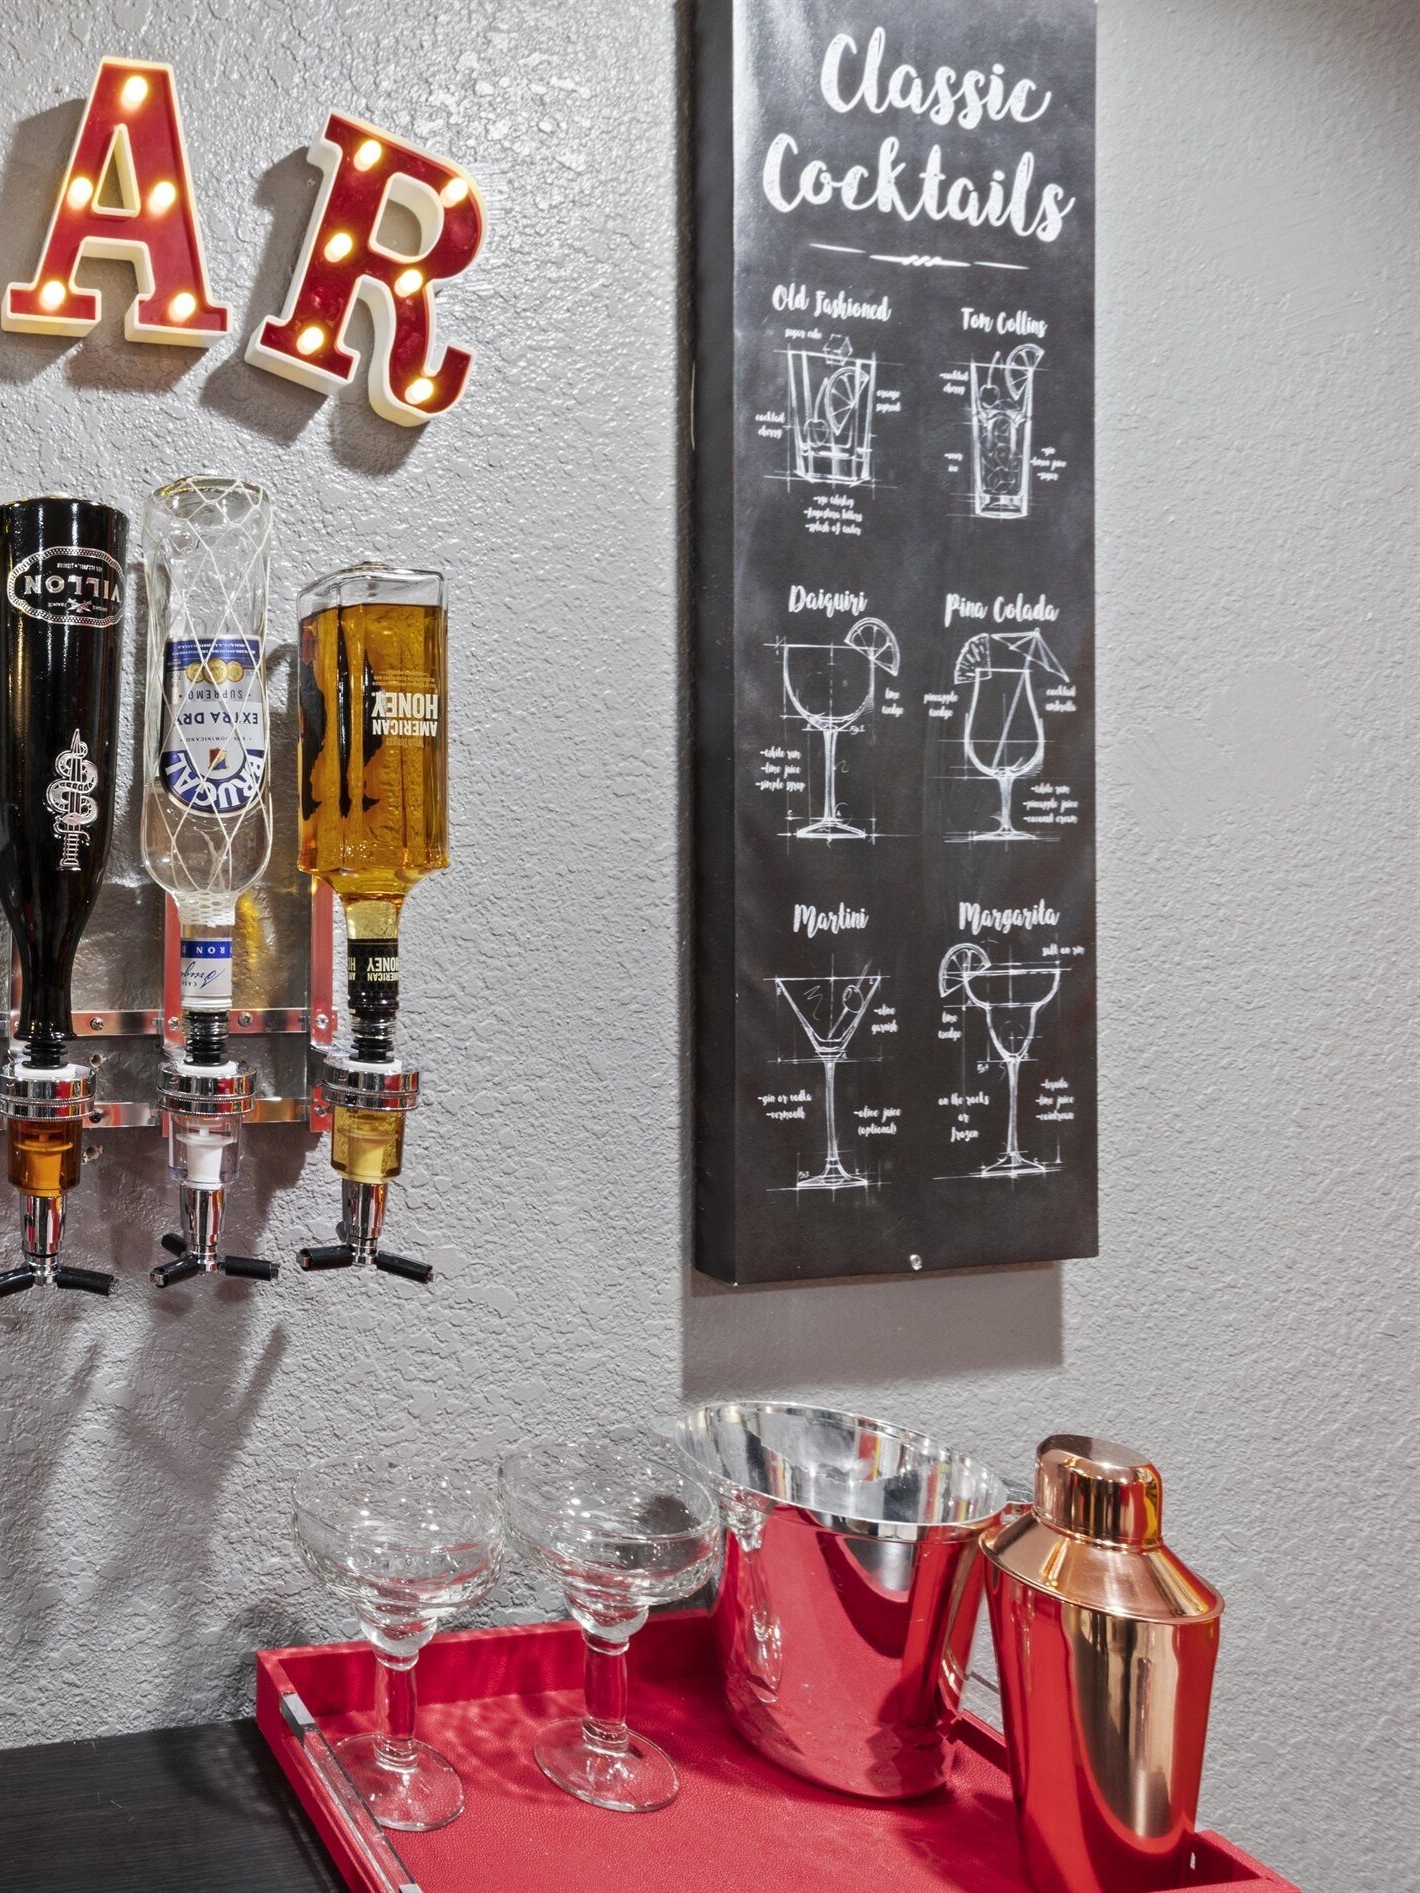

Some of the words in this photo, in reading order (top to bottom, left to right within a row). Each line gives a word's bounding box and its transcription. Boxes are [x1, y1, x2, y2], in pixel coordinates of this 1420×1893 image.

[821, 27, 1051, 129] Classic
[763, 133, 1075, 242] Cocktails
[772, 283, 809, 311] Old
[814, 291, 891, 321] Fashioned
[961, 307, 993, 332] Tom
[997, 310, 1048, 338] Collins
[23, 575, 121, 603] VILLON
[788, 585, 868, 618] Daiquiri
[944, 593, 988, 628] Pina
[993, 593, 1060, 622] Colada
[187, 689, 243, 700] SUPREMO
[172, 711, 206, 726] DRY
[210, 711, 258, 726] EXTRA
[372, 720, 438, 737] AMERICAN
[164, 752, 264, 809] BRUGAL
[793, 902, 869, 938] Martini
[958, 898, 1060, 935] Margarita
[196, 946, 226, 954] RON
